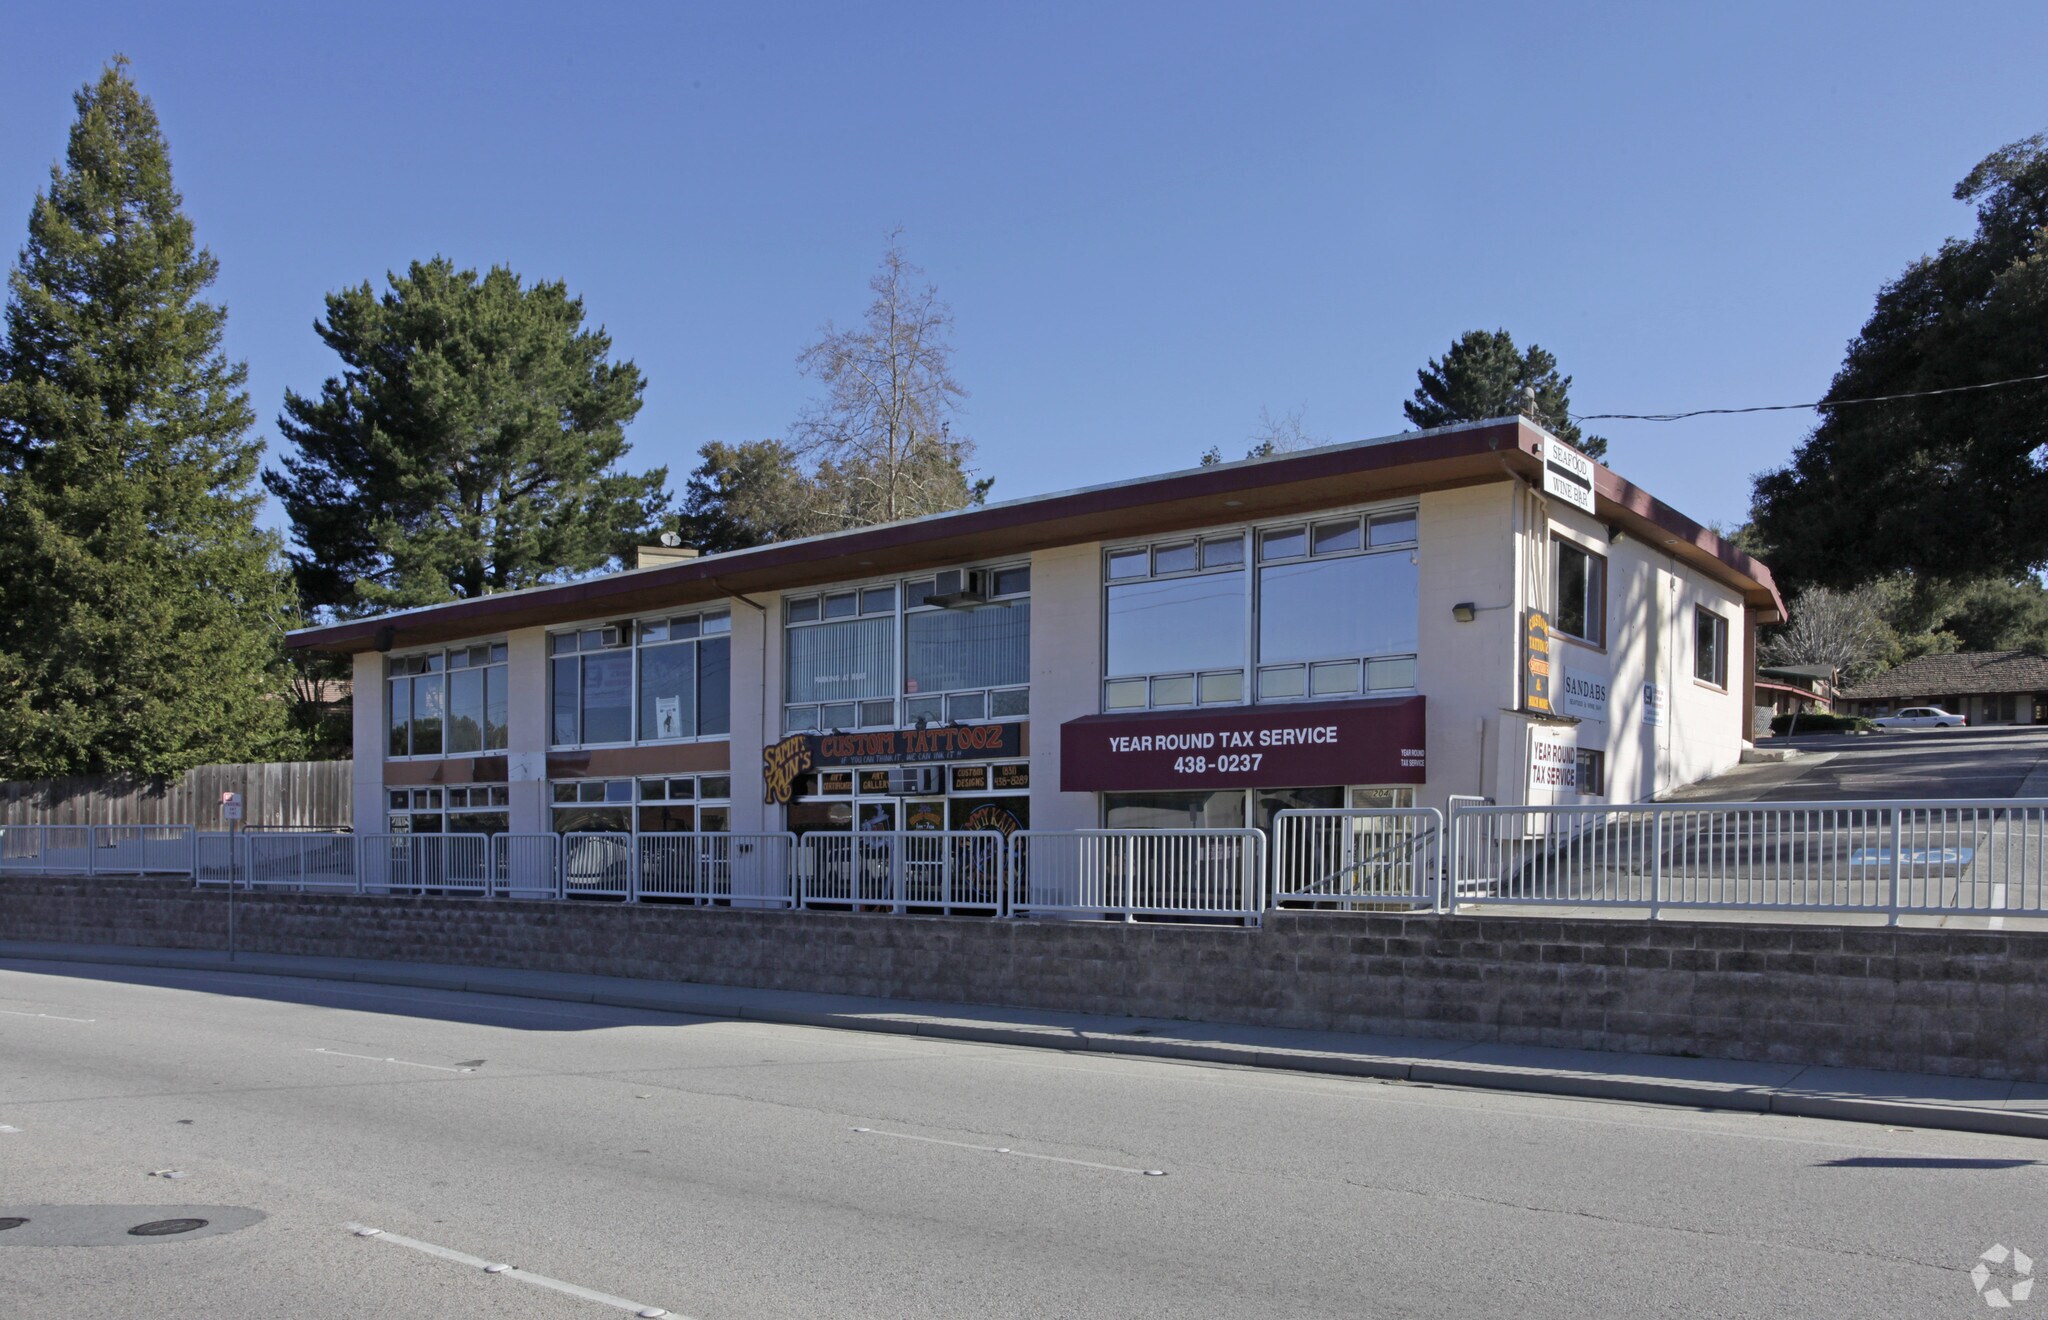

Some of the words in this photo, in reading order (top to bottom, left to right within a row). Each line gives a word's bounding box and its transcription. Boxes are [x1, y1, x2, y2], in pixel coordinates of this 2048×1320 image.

[1552, 445, 1587, 475] SEAFOOD
[1552, 477, 1573, 499] WINE
[1573, 487, 1588, 507] BAR
[1565, 676, 1606, 702] SANDABS
[821, 732, 896, 758] CUSTOM
[902, 725, 1003, 753] TATTOOZ
[1109, 736, 1152, 753] YEAR
[1157, 733, 1215, 751] ROUND
[1219, 731, 1255, 749] TAX
[1259, 726, 1338, 747] SERVICE
[840, 757, 847, 765] IF
[850, 756, 862, 764] YOU
[863, 755, 875, 764] CAN
[906, 752, 917, 761] WE
[918, 751, 931, 760] CAN
[947, 750, 955, 759] IT
[1400, 748, 1411, 757] YEAR
[1411, 749, 1425, 757] ROUND
[1400, 758, 1409, 767] TAX
[1409, 759, 1425, 767] SERVICE
[1534, 741, 1552, 763] YEAR
[1552, 745, 1575, 765] ROUND
[957, 767, 984, 777] CUSTOM
[1174, 753, 1263, 774] 438-0237
[871, 771, 885, 780] ART
[956, 777, 985, 788] DESIGNS
[1533, 764, 1546, 784] TAX
[1547, 766, 1575, 787] SERVICE
[1372, 789, 1390, 797] 204
